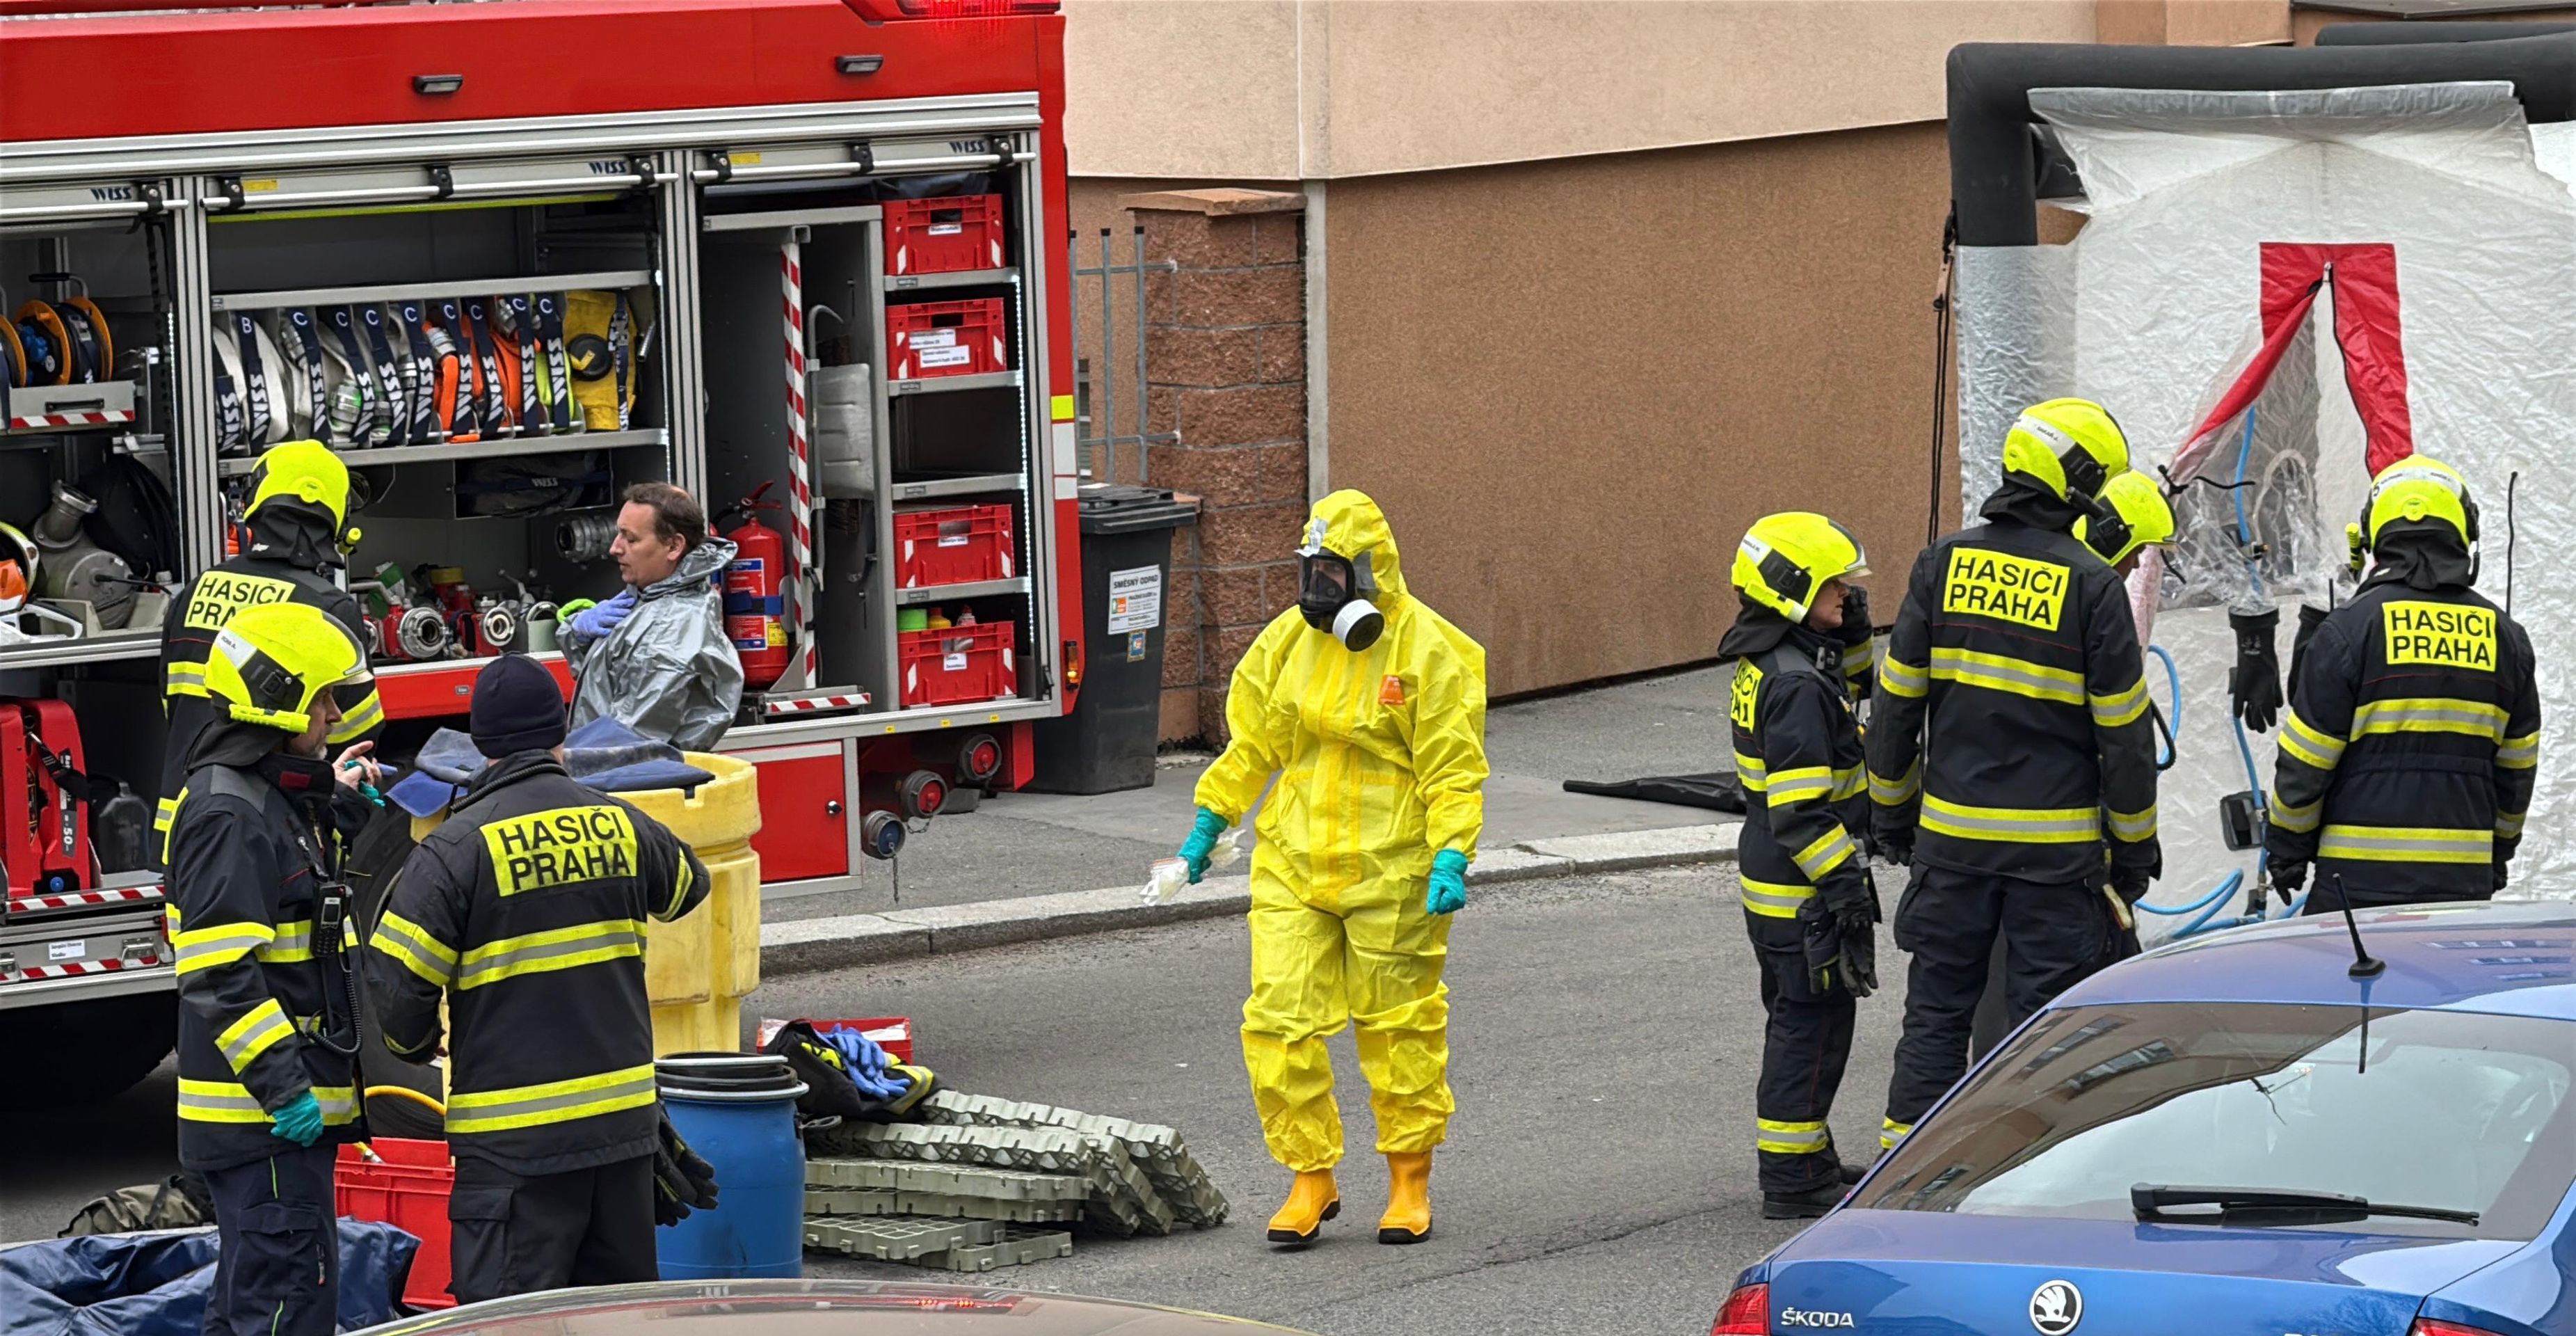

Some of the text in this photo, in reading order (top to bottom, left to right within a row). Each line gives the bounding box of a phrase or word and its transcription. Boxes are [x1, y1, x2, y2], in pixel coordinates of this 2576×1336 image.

[949, 141, 985, 153] WISS
[589, 161, 626, 174] WISS
[90, 187, 131, 200] WISS
[443, 304, 456, 319] C
[470, 305, 483, 320] C
[512, 298, 526, 311] C
[540, 298, 553, 314] C
[293, 312, 308, 326] C
[335, 312, 348, 327] C
[366, 310, 378, 326] C
[404, 307, 417, 322] C
[241, 317, 252, 333] B
[1953, 557, 2063, 596] HASIČI
[197, 578, 286, 605] HASIČI
[1949, 584, 2051, 625] PRAHA
[189, 601, 237, 627] PRA
[2391, 609, 2490, 638] HASIČI
[2393, 635, 2491, 667] PRAHA
[497, 807, 625, 855] HASIČI
[509, 843, 631, 891] PRAHA
[1781, 1307, 1855, 1328] ŠKODA
